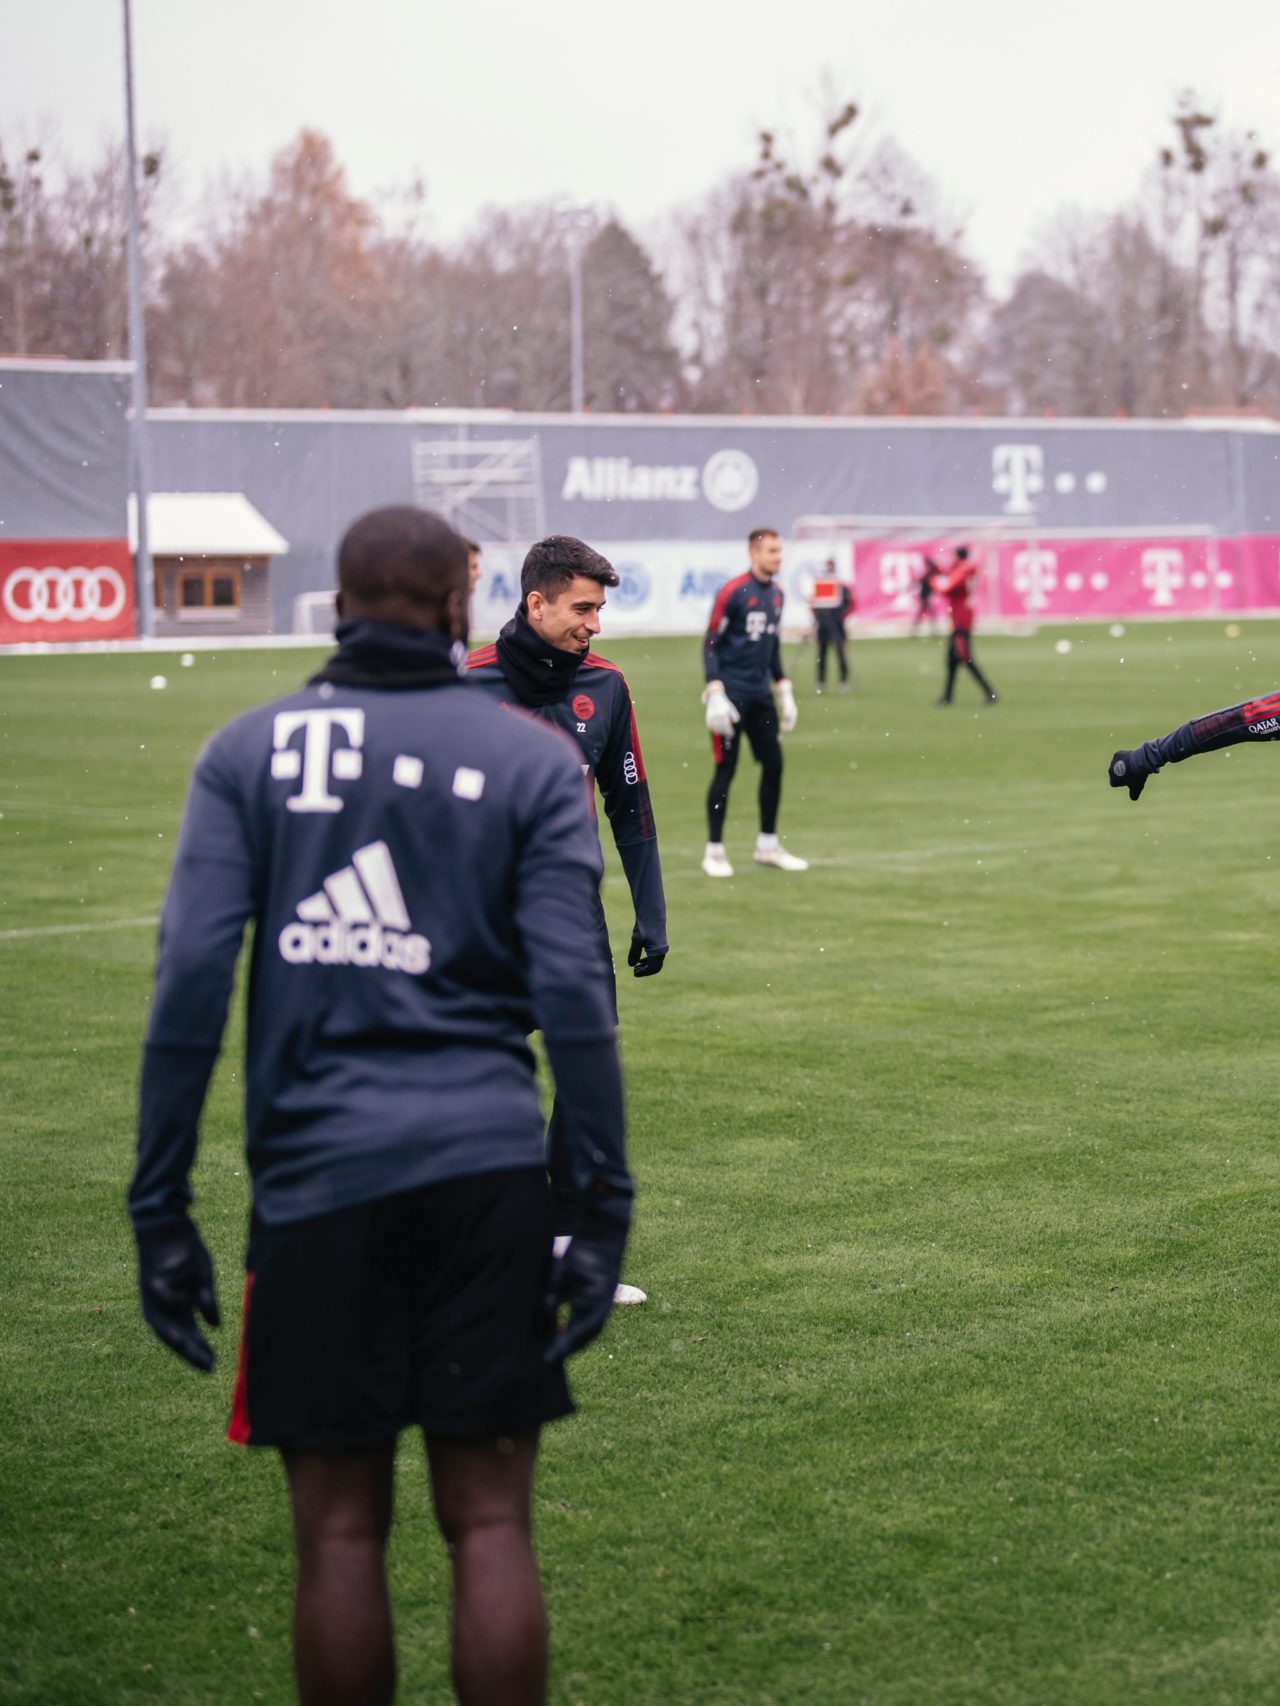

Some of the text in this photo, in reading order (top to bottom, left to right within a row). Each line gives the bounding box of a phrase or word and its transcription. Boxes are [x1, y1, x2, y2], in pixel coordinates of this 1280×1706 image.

[561, 456, 699, 501] Allianz
[576, 722, 586, 733] 22
[1248, 717, 1279, 734] QATAR
